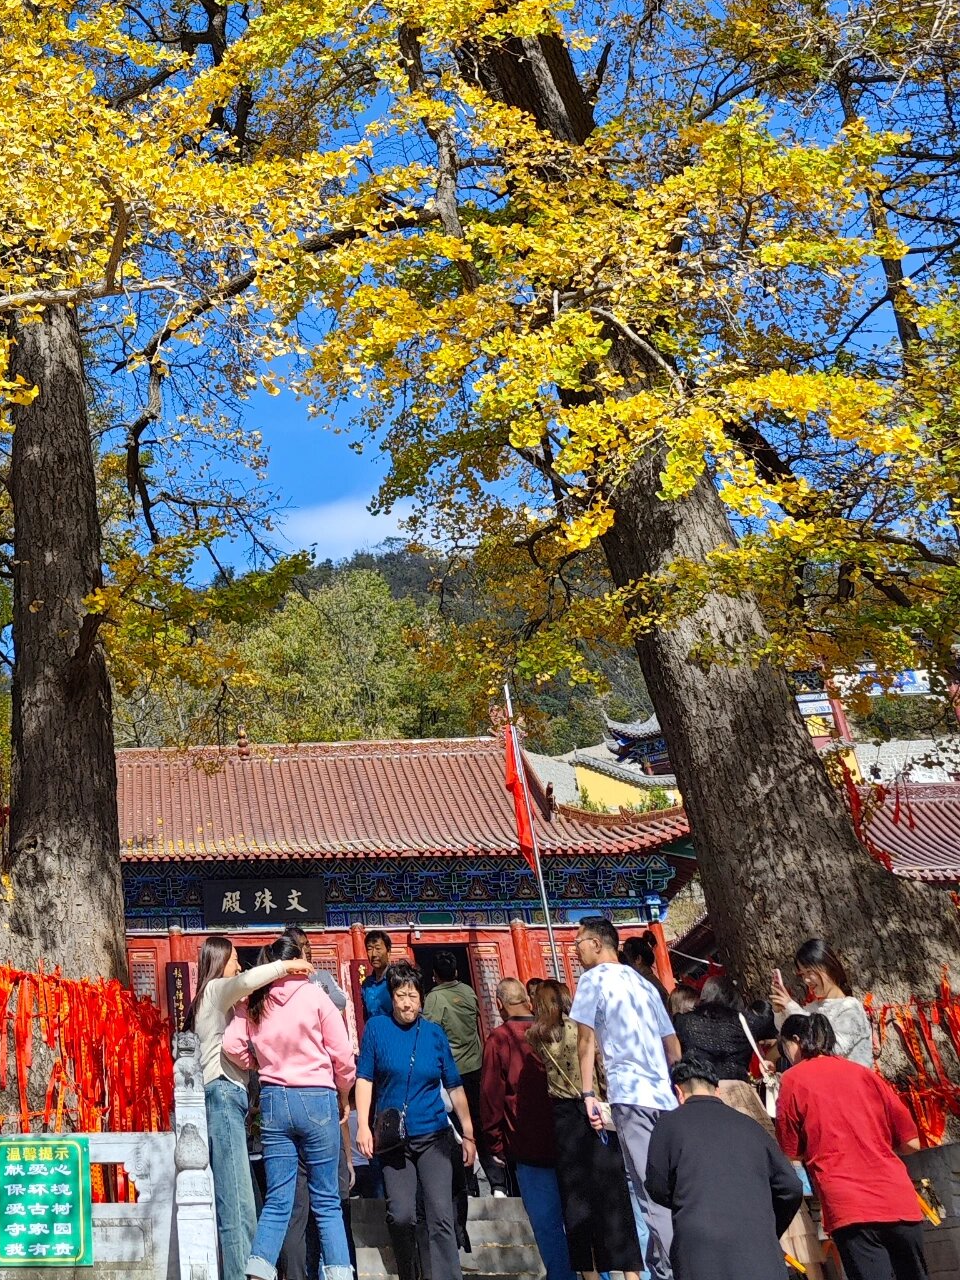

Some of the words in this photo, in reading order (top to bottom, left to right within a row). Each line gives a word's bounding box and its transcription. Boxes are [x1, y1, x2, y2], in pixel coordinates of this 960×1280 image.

[6, 1146, 70, 1161] 温馨提示
[3, 1163, 72, 1176] 献爱心
[3, 1183, 73, 1196] 保环境
[4, 1202, 73, 1216] 爱古树
[4, 1222, 72, 1236] 守家园
[3, 1243, 75, 1256] 我有责
